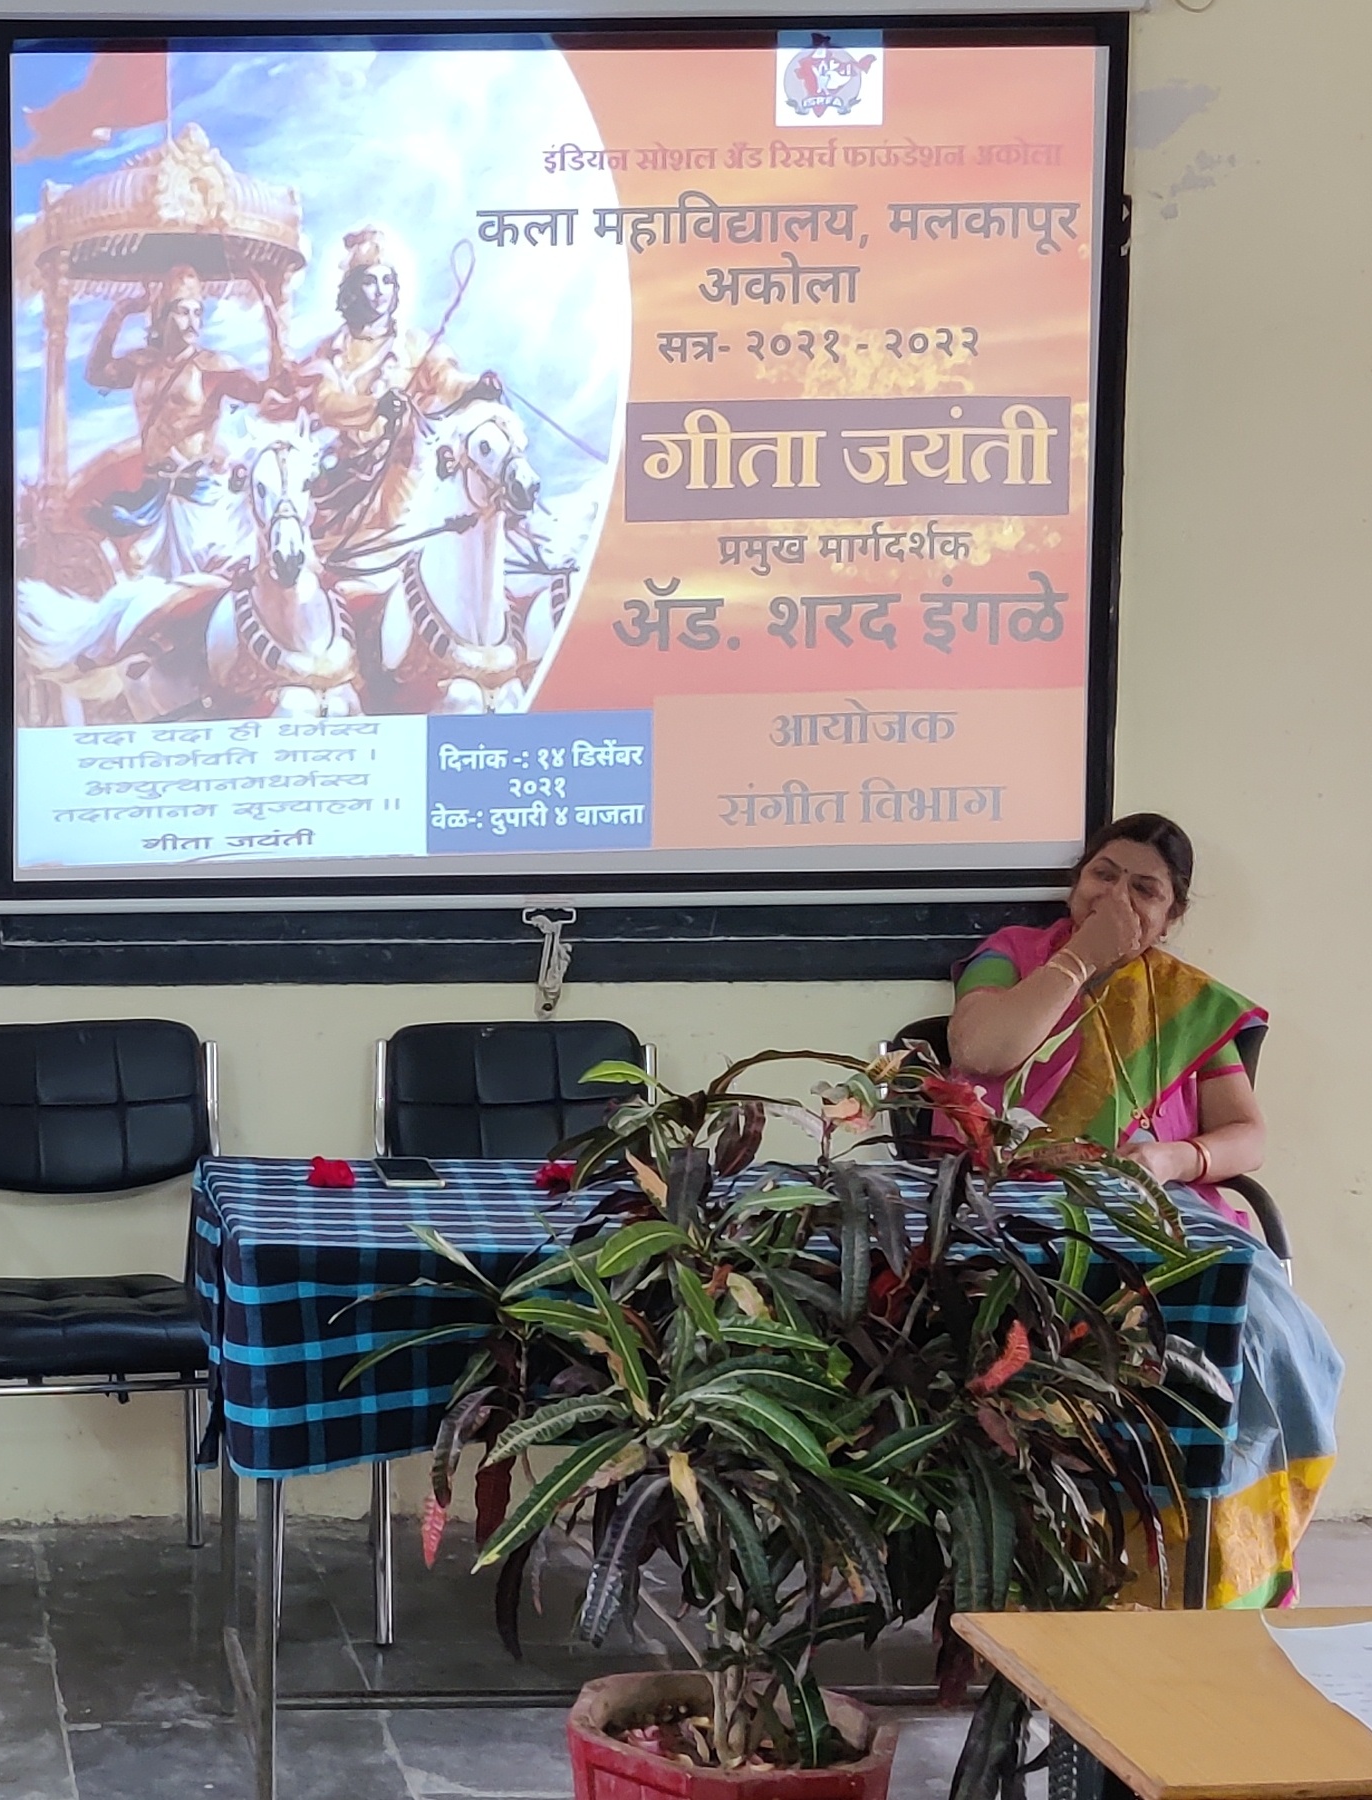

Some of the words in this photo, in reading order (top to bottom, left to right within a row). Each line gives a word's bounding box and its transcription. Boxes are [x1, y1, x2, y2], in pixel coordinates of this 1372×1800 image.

[543, 142, 630, 173] इंडियन
[635, 141, 718, 171] सोशल
[769, 137, 838, 168] रिसर्च
[842, 137, 966, 168] फाऊंडेशन
[976, 137, 1064, 167] अकोला
[476, 208, 579, 247] कला
[594, 190, 869, 254] महाविद्यालय,
[887, 200, 1081, 254] मलकापूर
[698, 251, 862, 306] अकोला
[656, 331, 730, 363] सत्र-
[746, 329, 841, 363] २०२१
[884, 327, 979, 359] २०२२
[641, 408, 827, 491] गीता
[841, 403, 1058, 487] जयंती
[717, 535, 809, 576] प्रमुख
[818, 520, 973, 563] मार्गदर्शक
[767, 593, 903, 651] शरद
[920, 571, 1069, 655] इंगळे
[73, 730, 137, 746] यदा
[151, 728, 214, 743] यदा
[228, 720, 262, 742] ही
[278, 719, 381, 738] धर्मस्य
[769, 698, 959, 748] आयोजक
[274, 748, 358, 763] भारत
[438, 742, 510, 772] दिनांक
[536, 747, 566, 770] १४
[570, 739, 645, 767] डिसेंबर
[509, 776, 567, 798] २०२१
[718, 780, 850, 827] संगीत
[859, 775, 1008, 825] विभाग
[52, 803, 219, 823] तदात्मानम
[489, 799, 549, 835] दुपारी
[554, 806, 569, 827] ४
[574, 804, 646, 826] वाजता
[140, 833, 215, 851] गीता
[224, 828, 317, 848] जयंती
